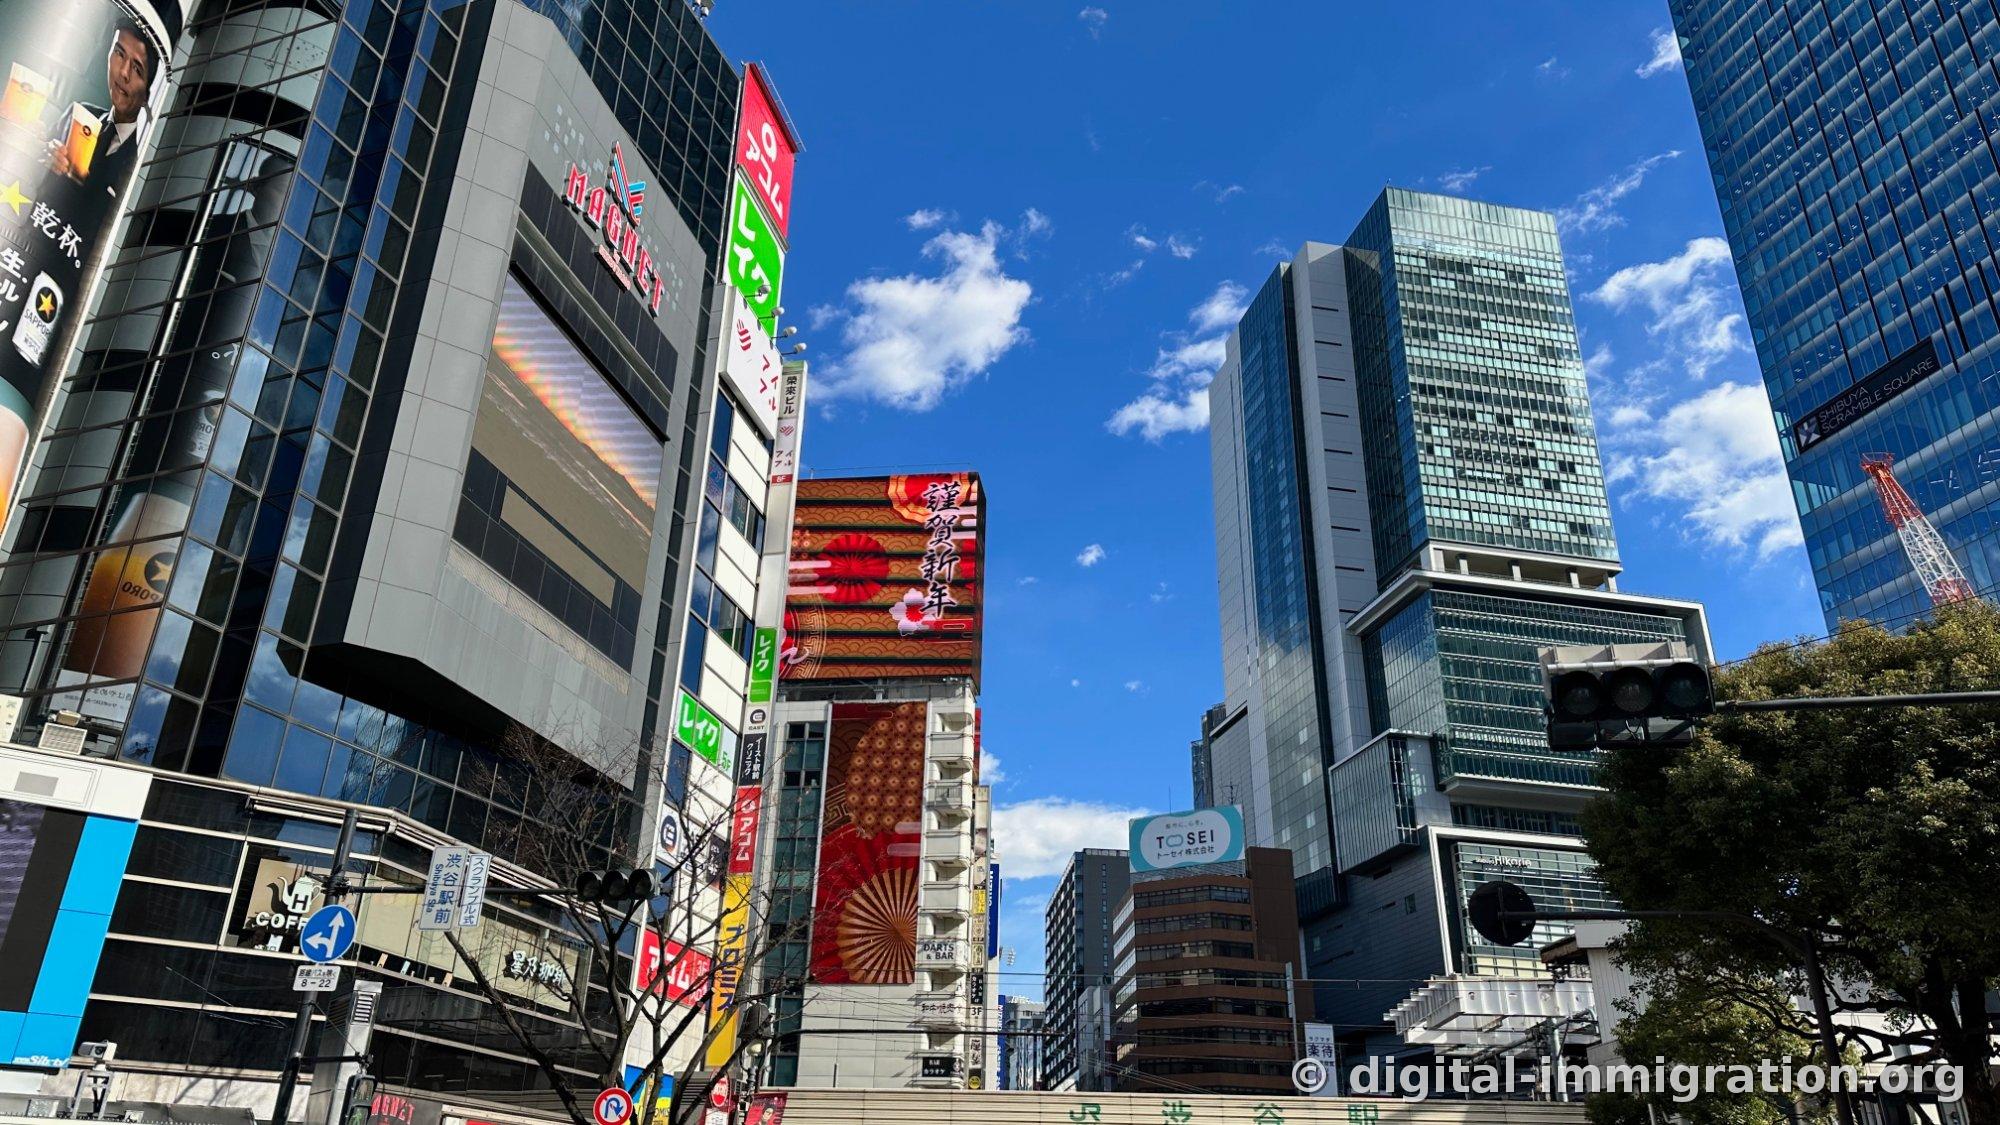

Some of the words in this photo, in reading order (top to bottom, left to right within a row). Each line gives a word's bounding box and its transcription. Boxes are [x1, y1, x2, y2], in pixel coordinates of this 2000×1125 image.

[746, 129, 783, 220] アコム
[565, 162, 664, 317] MAGNET
[733, 193, 771, 304] レイク
[1819, 386, 1869, 422] SHIBUYA
[1822, 391, 1882, 433] SCRAMBLE
[1884, 357, 1935, 396] SQUARE
[921, 482, 961, 615] 謹賀新年
[756, 634, 771, 672] レイク
[682, 703, 718, 747] レイク
[736, 816, 754, 861] アコム
[1156, 829, 1214, 849] TOSEI
[1157, 845, 1214, 860] トーセイ株式会社
[431, 863, 444, 896] Shibuya
[434, 853, 462, 924] 渋谷駅前
[463, 857, 484, 925] スクランブル式
[255, 911, 308, 930] COFF
[924, 943, 954, 951] DARTS
[935, 952, 954, 960] BAR
[371, 1094, 415, 1124] AGNET
